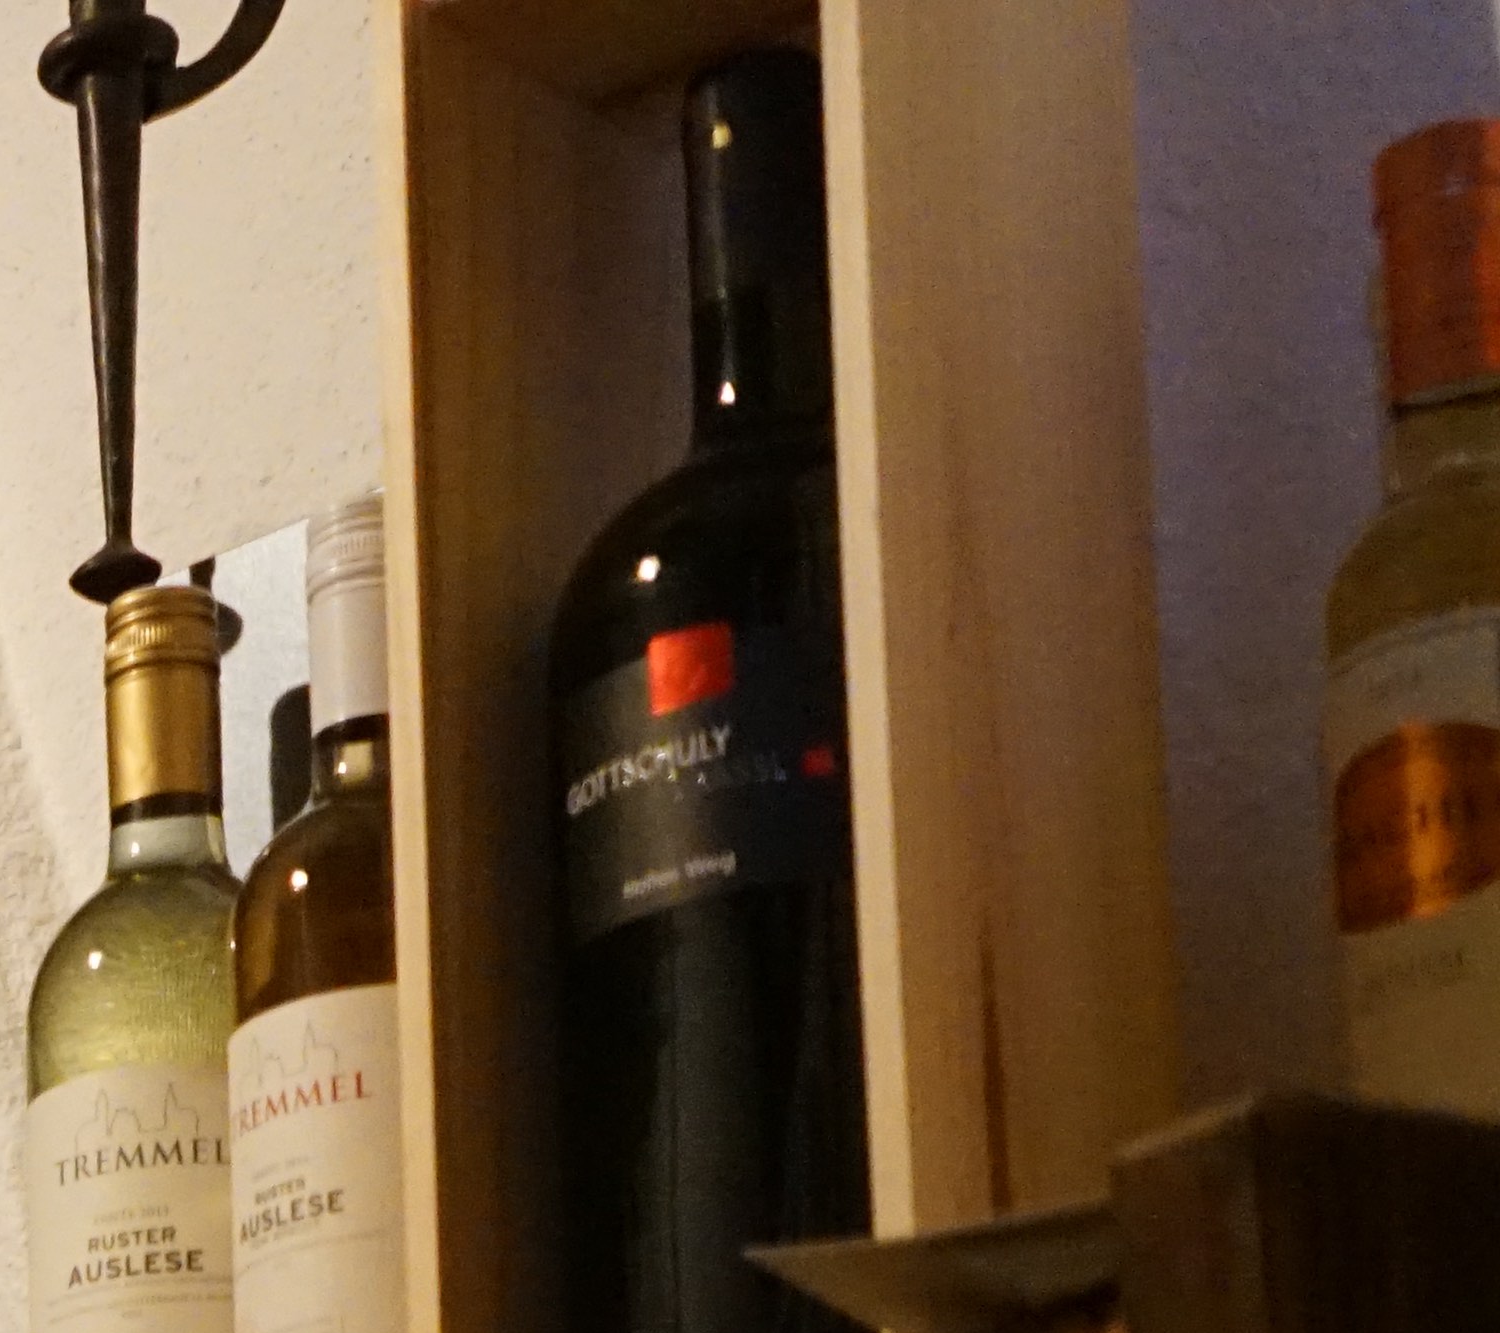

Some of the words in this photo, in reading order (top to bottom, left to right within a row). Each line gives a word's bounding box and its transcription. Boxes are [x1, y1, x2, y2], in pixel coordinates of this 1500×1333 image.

[55, 1136, 234, 1188] TREMMEL
[87, 1224, 177, 1252] RUSTER
[240, 1189, 345, 1244] AUSLESE
[68, 1249, 204, 1289] AUSLESE
